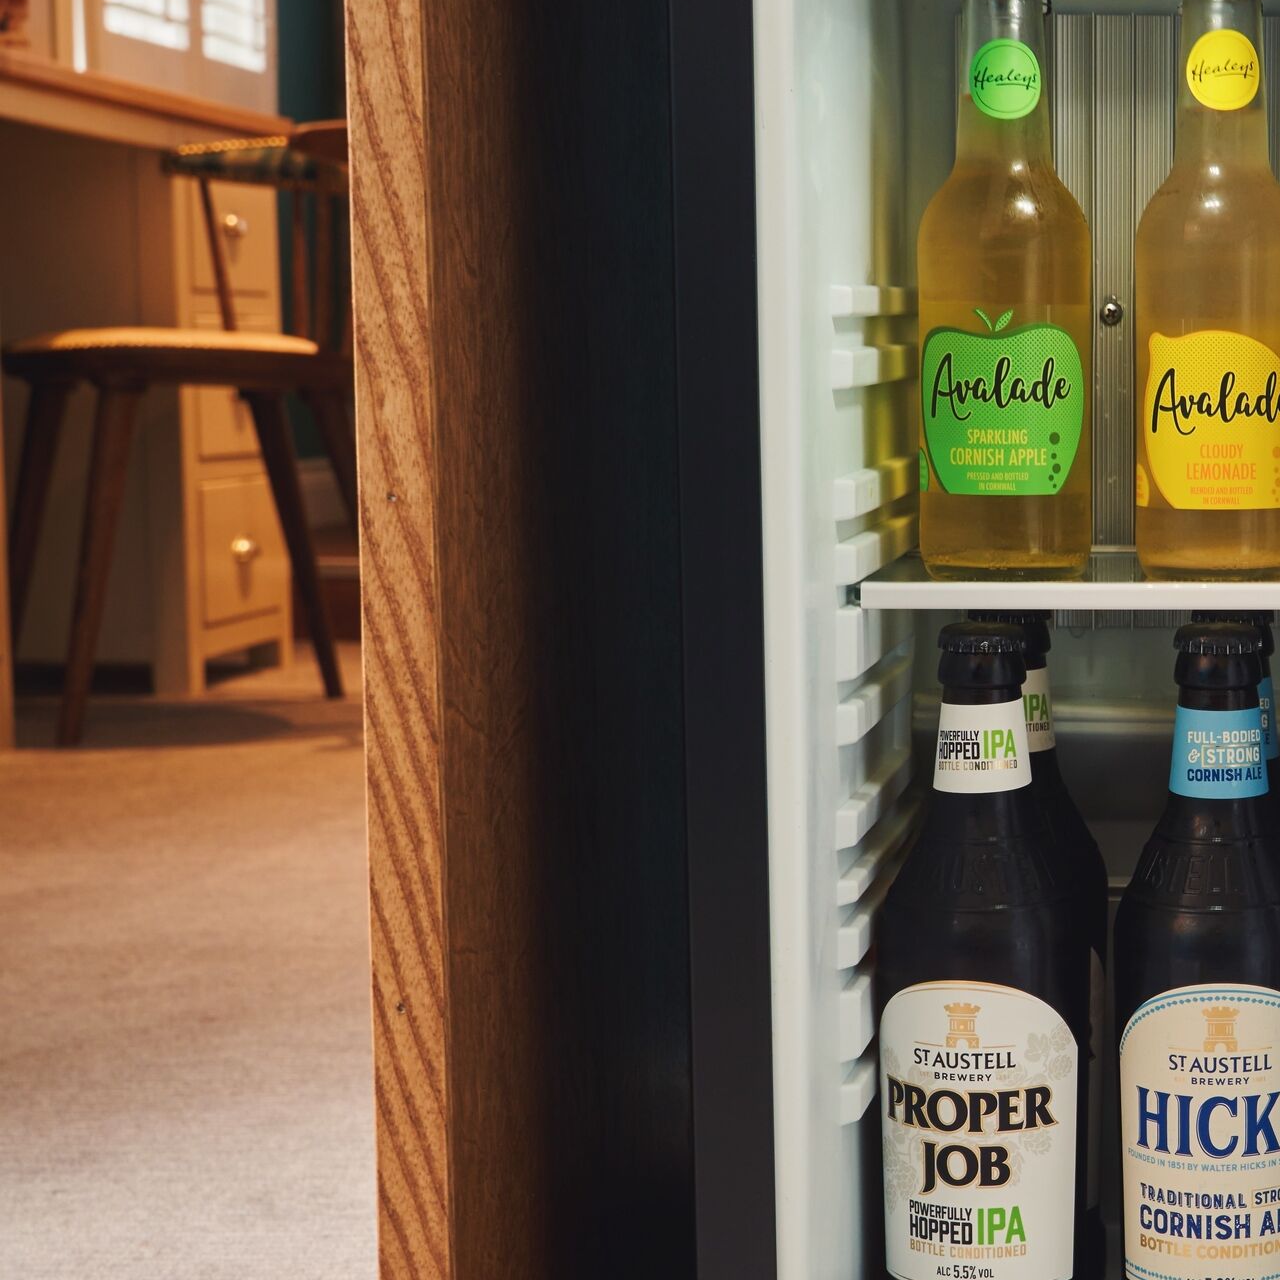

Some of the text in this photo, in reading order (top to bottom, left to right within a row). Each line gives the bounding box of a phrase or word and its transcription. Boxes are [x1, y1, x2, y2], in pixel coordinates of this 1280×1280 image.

[974, 66, 1038, 91] Healeys
[1192, 57, 1255, 83] Healeys
[931, 352, 1072, 421] Avalade
[967, 428, 1028, 445] SPARKLING
[950, 447, 1048, 466] CORNISH APPLE
[1199, 443, 1244, 459] CLOUDY
[966, 472, 1029, 481] PRESSED AND BOTTLED
[1186, 463, 1257, 480] LEMONADE
[1190, 486, 1215, 495] BLENDED
[1215, 486, 1229, 495] AND
[1210, 496, 1240, 505] CORNWALL
[939, 728, 1017, 760] HOPPED IPA
[1187, 729, 1261, 744] FULL-BODIED
[1188, 747, 1260, 764] & STRONG
[1187, 766, 1262, 782] CORNISH ALE
[932, 1050, 1017, 1070] AUSTELL
[1189, 1053, 1273, 1074] AUSTELL
[934, 1071, 993, 1082] BREWERY
[1191, 1076, 1250, 1086] BREWERY
[886, 1073, 1059, 1134] PROPER
[918, 1139, 1012, 1196] JOB
[1127, 1147, 1156, 1166] FOUNDED
[1157, 1158, 1166, 1168] IN
[1167, 1160, 1185, 1171] 1851
[1187, 1163, 1198, 1172] BY
[1201, 1162, 1238, 1173] WALTER
[1240, 1160, 1266, 1171] HICKS
[1268, 1158, 1278, 1168] IN
[1140, 1182, 1248, 1210] TRADITIONAL
[909, 1198, 973, 1221] POWERFULLY
[909, 1205, 1027, 1246] HOPPED IPA
[1140, 1203, 1251, 1241] CORNISH
[909, 1238, 1027, 1260] BOTTLE CONDITIONED
[1139, 1232, 1192, 1257] BOTTLE
[936, 1264, 995, 1280] ALC 5.5% VOL
